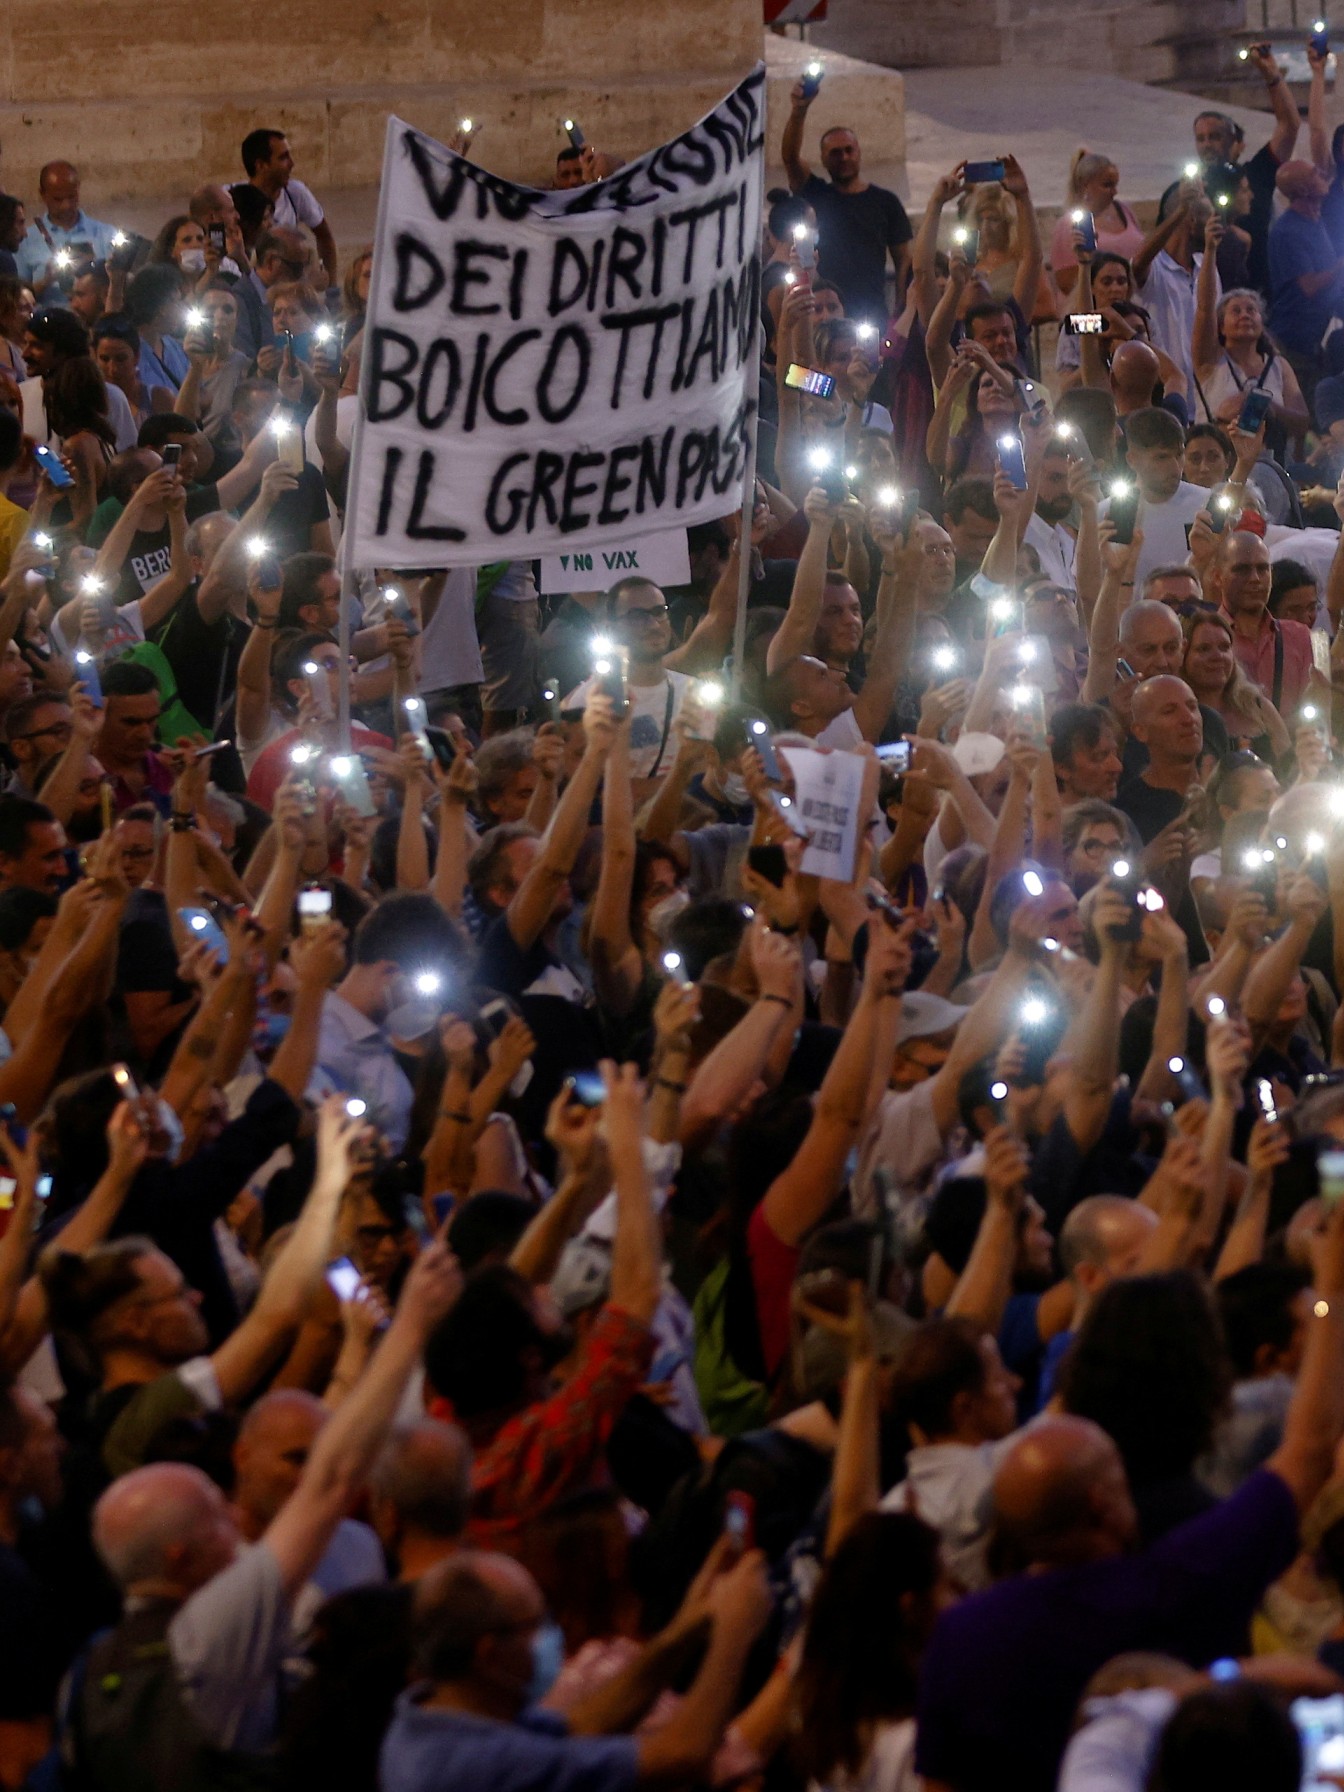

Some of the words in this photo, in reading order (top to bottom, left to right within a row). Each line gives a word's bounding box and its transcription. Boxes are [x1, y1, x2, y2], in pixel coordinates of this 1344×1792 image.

[392, 233, 528, 320] DEI
[547, 181, 747, 317] DIRITTI
[365, 250, 759, 432] BOICOTTIAMO
[375, 445, 466, 542] IL
[602, 550, 639, 570] VAX
